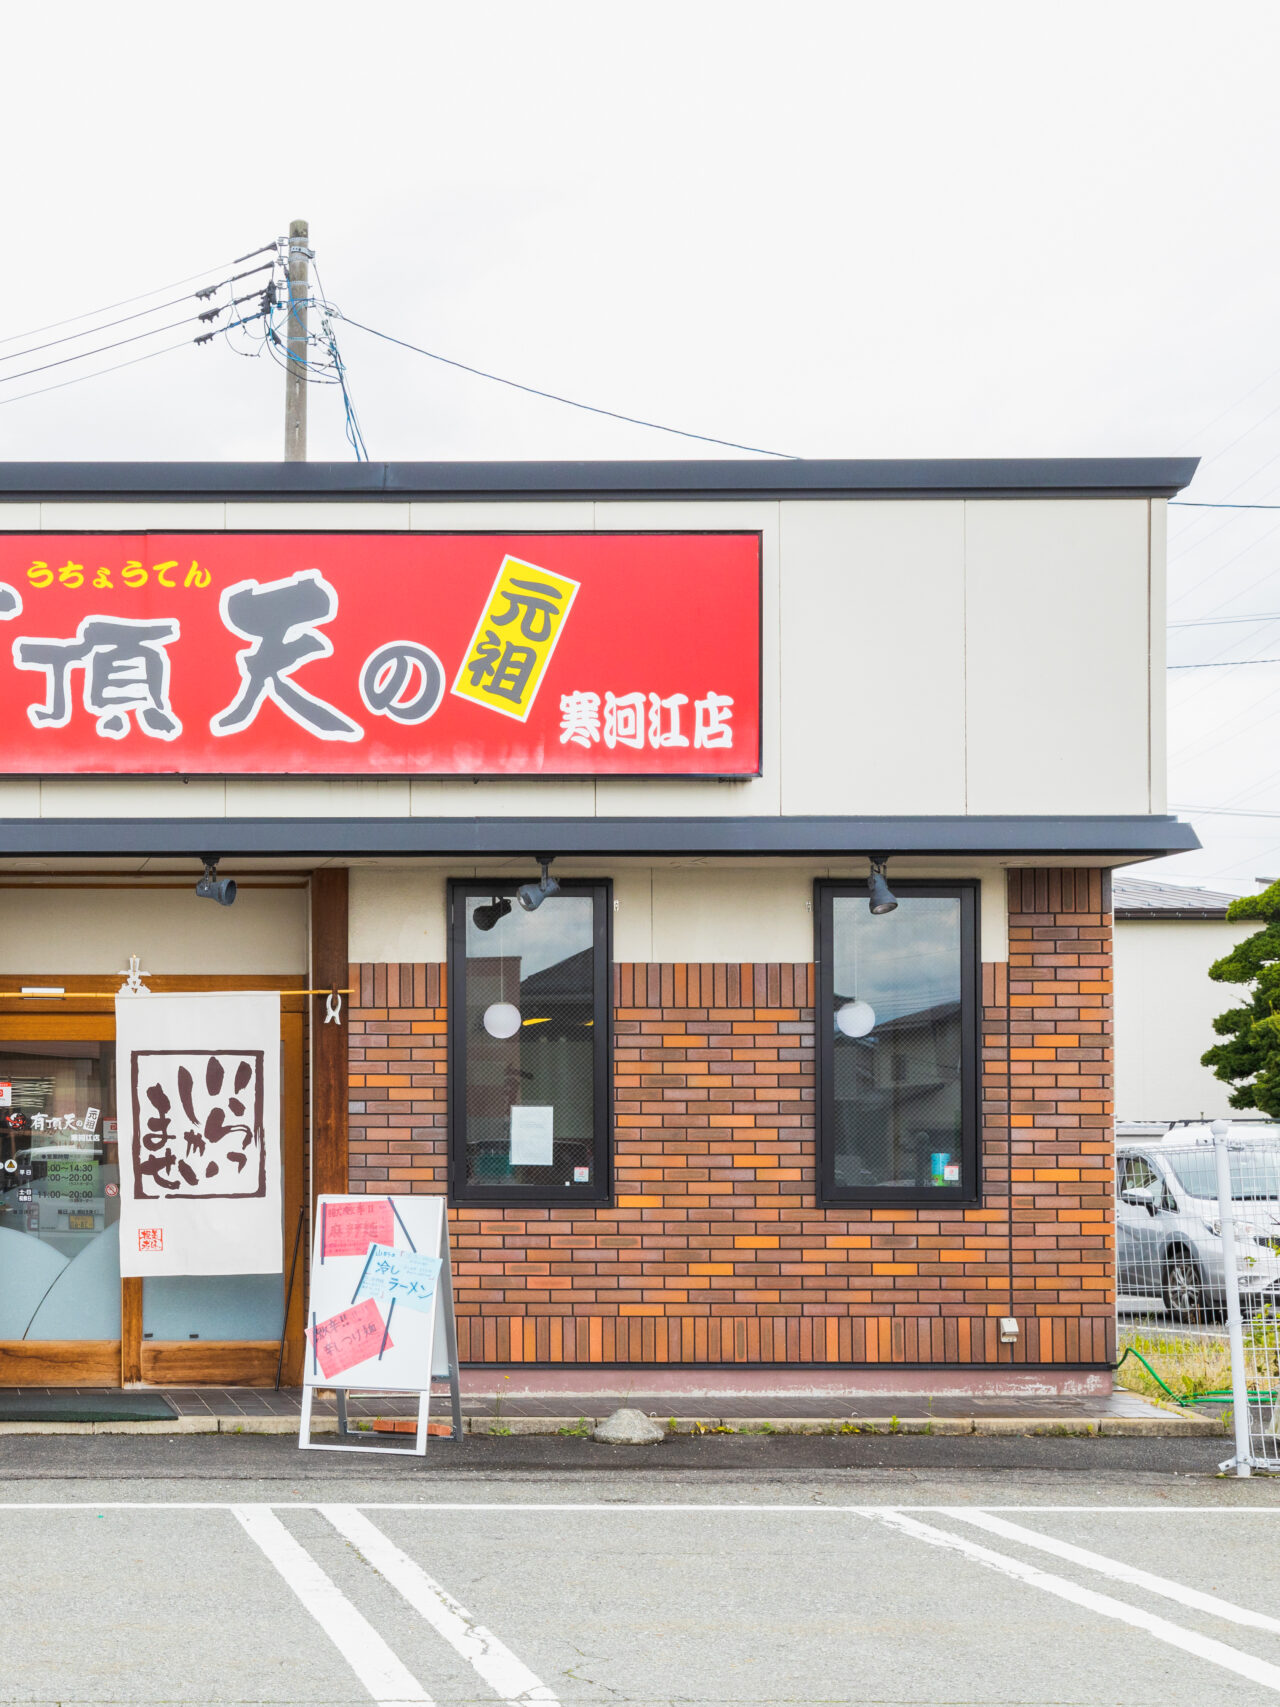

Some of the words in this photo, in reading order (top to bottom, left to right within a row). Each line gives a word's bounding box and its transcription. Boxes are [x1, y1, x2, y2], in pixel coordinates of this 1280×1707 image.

[26, 560, 212, 588] うちょうてん
[469, 574, 564, 706] 元祖
[558, 690, 735, 750] 寒河江店
[375, 1260, 400, 1275] 冷し
[388, 1278, 433, 1299] ラーメン
